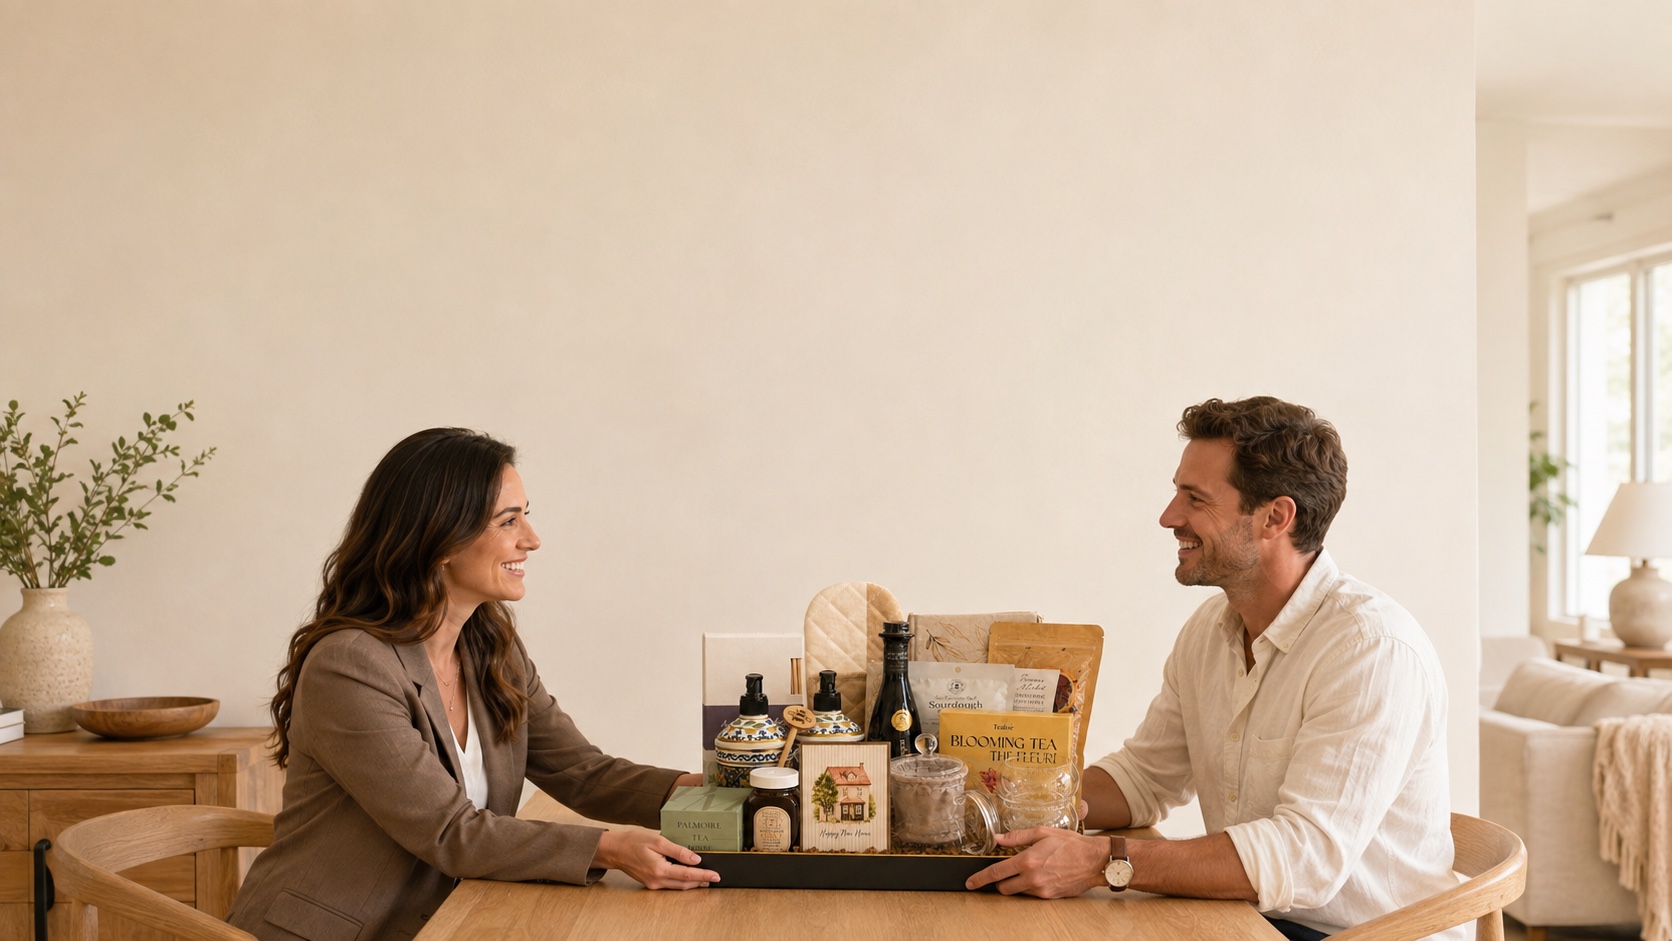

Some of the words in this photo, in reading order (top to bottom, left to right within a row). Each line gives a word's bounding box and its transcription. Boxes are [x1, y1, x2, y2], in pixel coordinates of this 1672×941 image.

[927, 700, 983, 710] Sourdough
[950, 734, 1025, 750] BLOOMING
[1029, 737, 1058, 751] TEA
[677, 821, 722, 830] PALMOIRE
[692, 834, 709, 842] TEA
